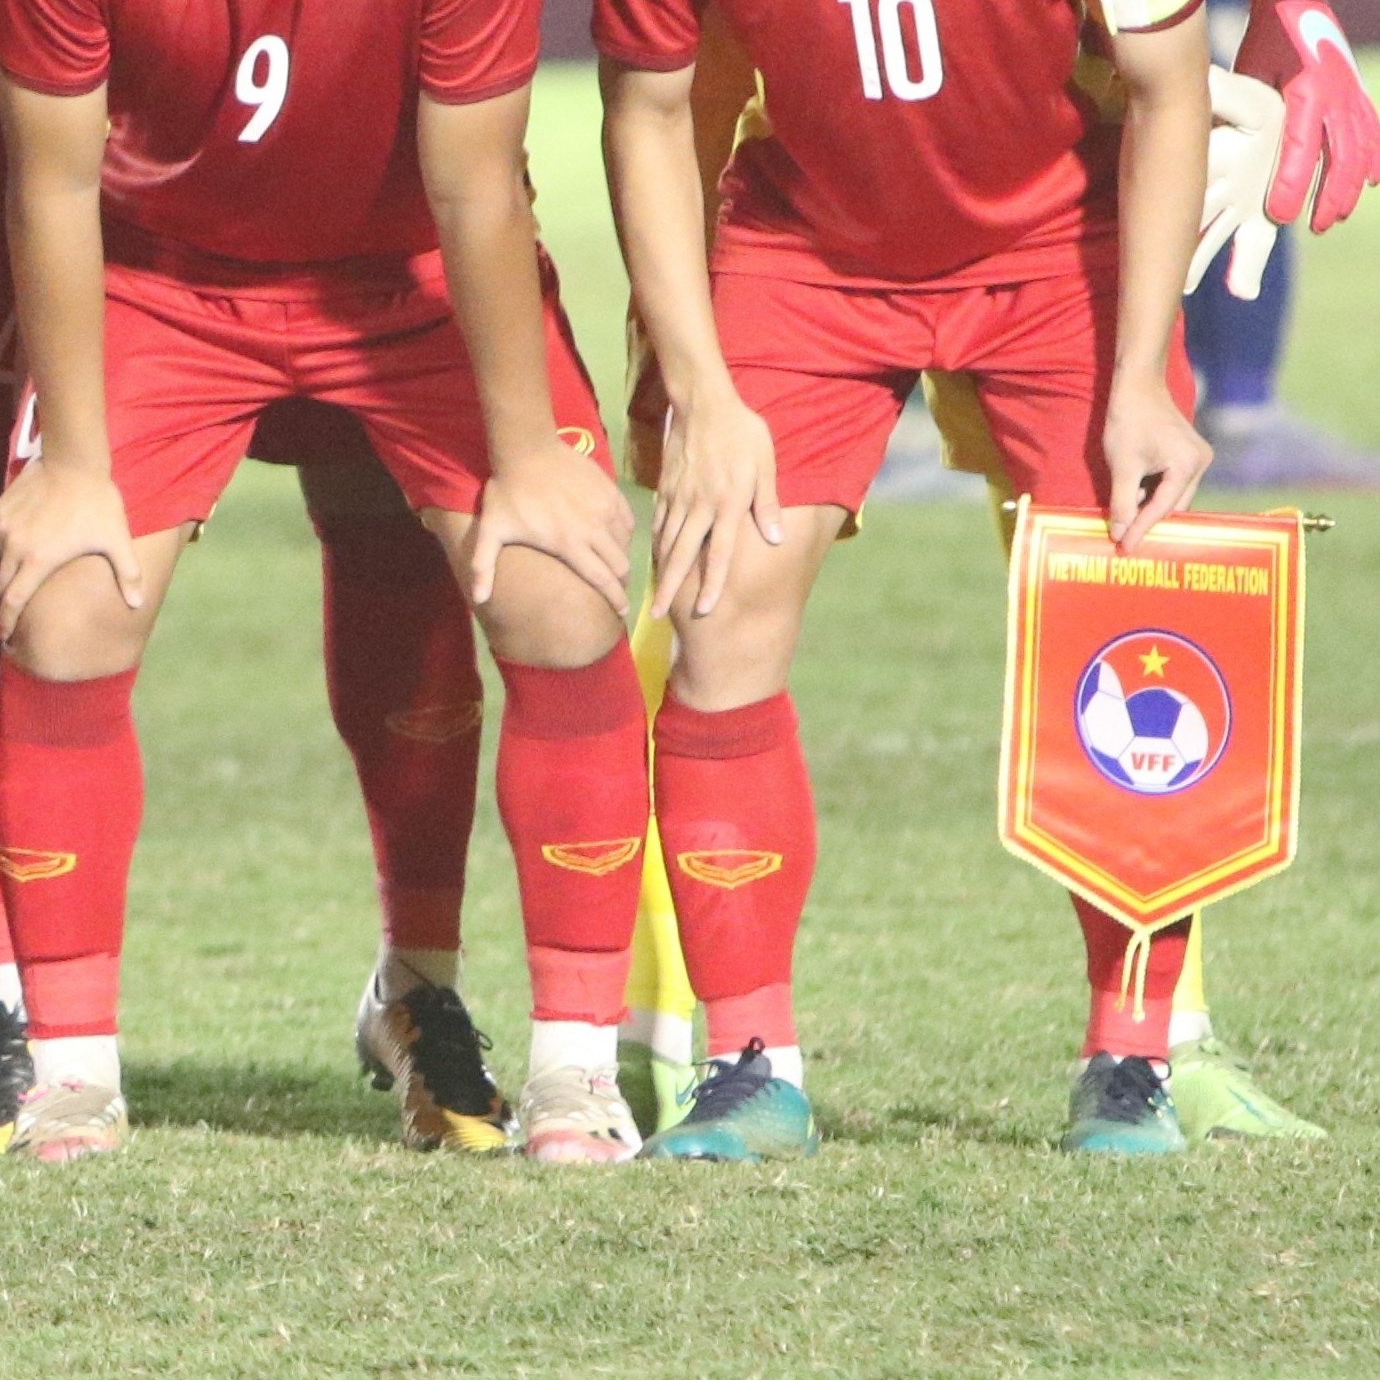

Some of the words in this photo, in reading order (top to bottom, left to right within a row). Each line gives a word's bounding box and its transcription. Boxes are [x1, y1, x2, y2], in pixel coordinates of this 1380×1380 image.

[235, 34, 289, 143] 9
[1048, 552, 1107, 584] VIETNAM
[1111, 556, 1180, 589] FOOTBALL
[1184, 562, 1270, 596] FEDERATION
[1131, 752, 1176, 772] VFF
